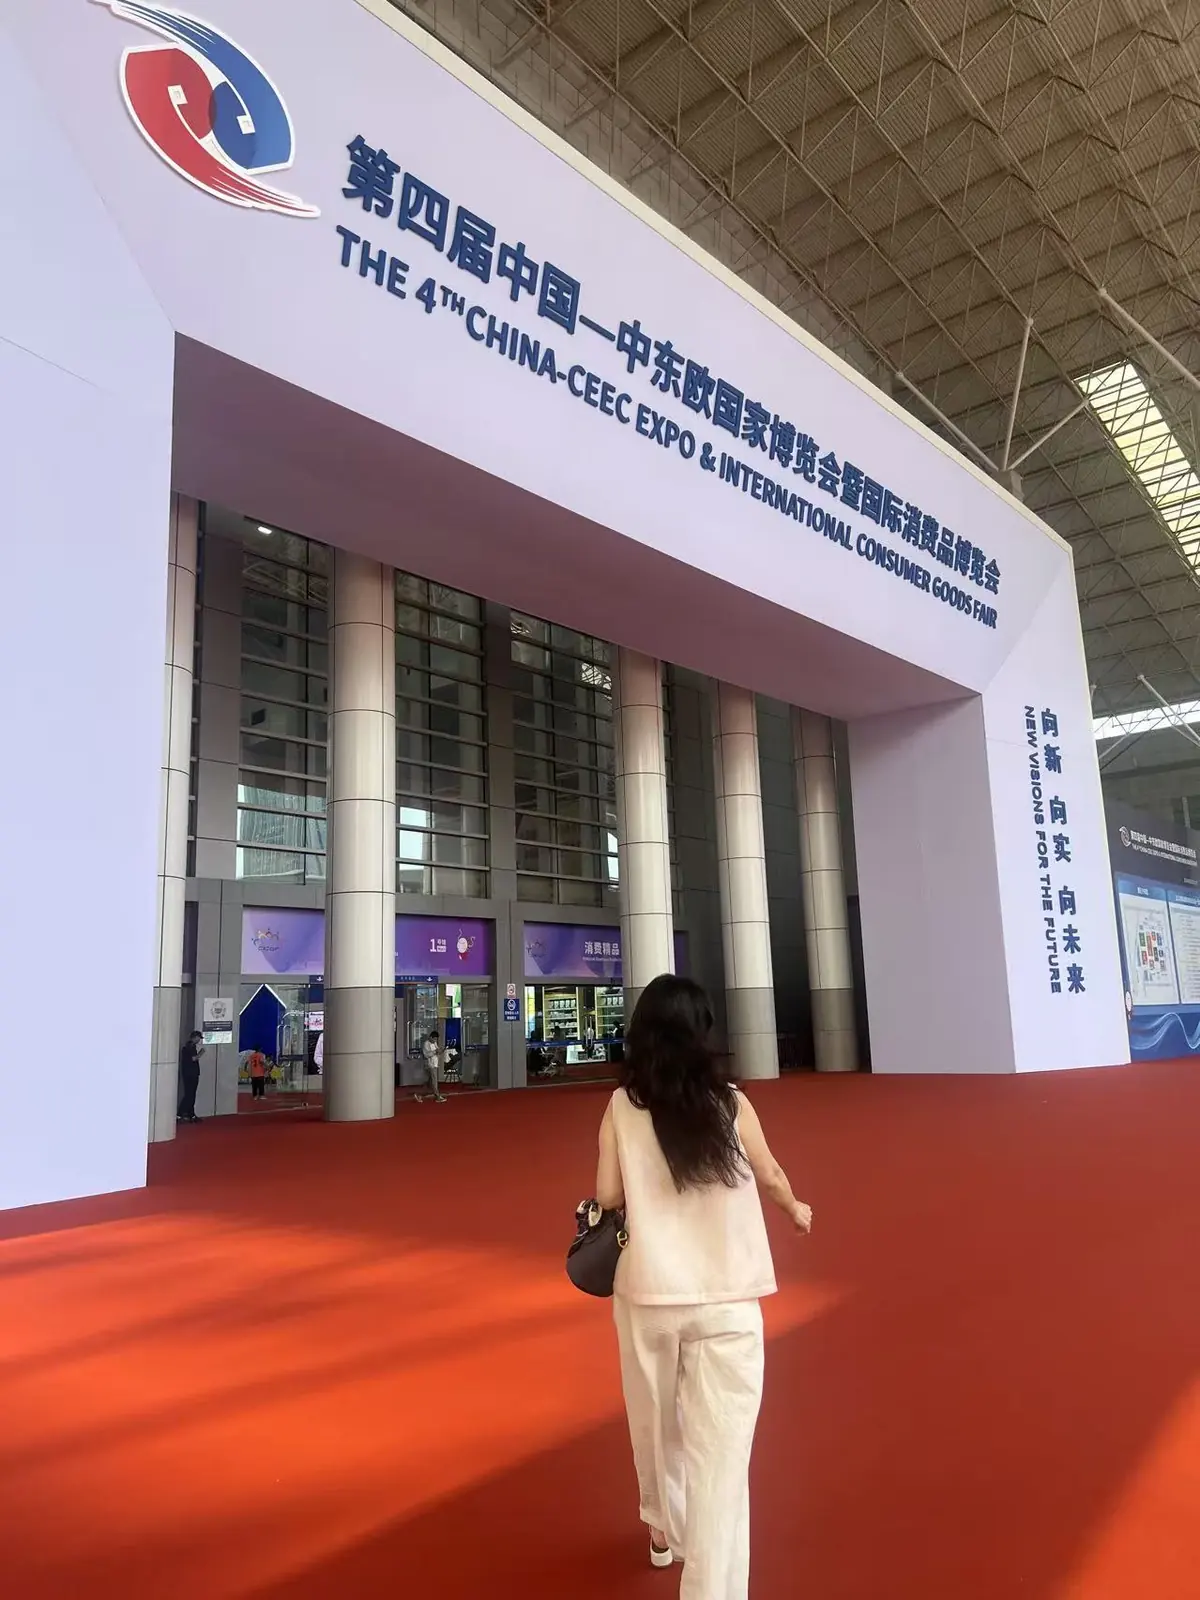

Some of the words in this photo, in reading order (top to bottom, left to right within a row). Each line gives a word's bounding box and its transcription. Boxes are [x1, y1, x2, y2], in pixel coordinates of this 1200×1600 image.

[336, 224, 410, 300] THE
[415, 277, 466, 314] 4TH
[465, 305, 632, 424] CHINA-CEEC
[635, 403, 696, 459] EXPO
[699, 442, 716, 472] &
[719, 452, 853, 551] INTERNATIONAL
[856, 533, 931, 593] CONSUMER
[932, 576, 973, 615] GOODS
[973, 603, 998, 629] FAIR
[1024, 705, 1038, 748] NEW
[1028, 751, 1045, 825] VISIONS
[1036, 830, 1049, 869] FOR
[1040, 874, 1053, 911] THE
[1044, 917, 1062, 994] FUTURE
